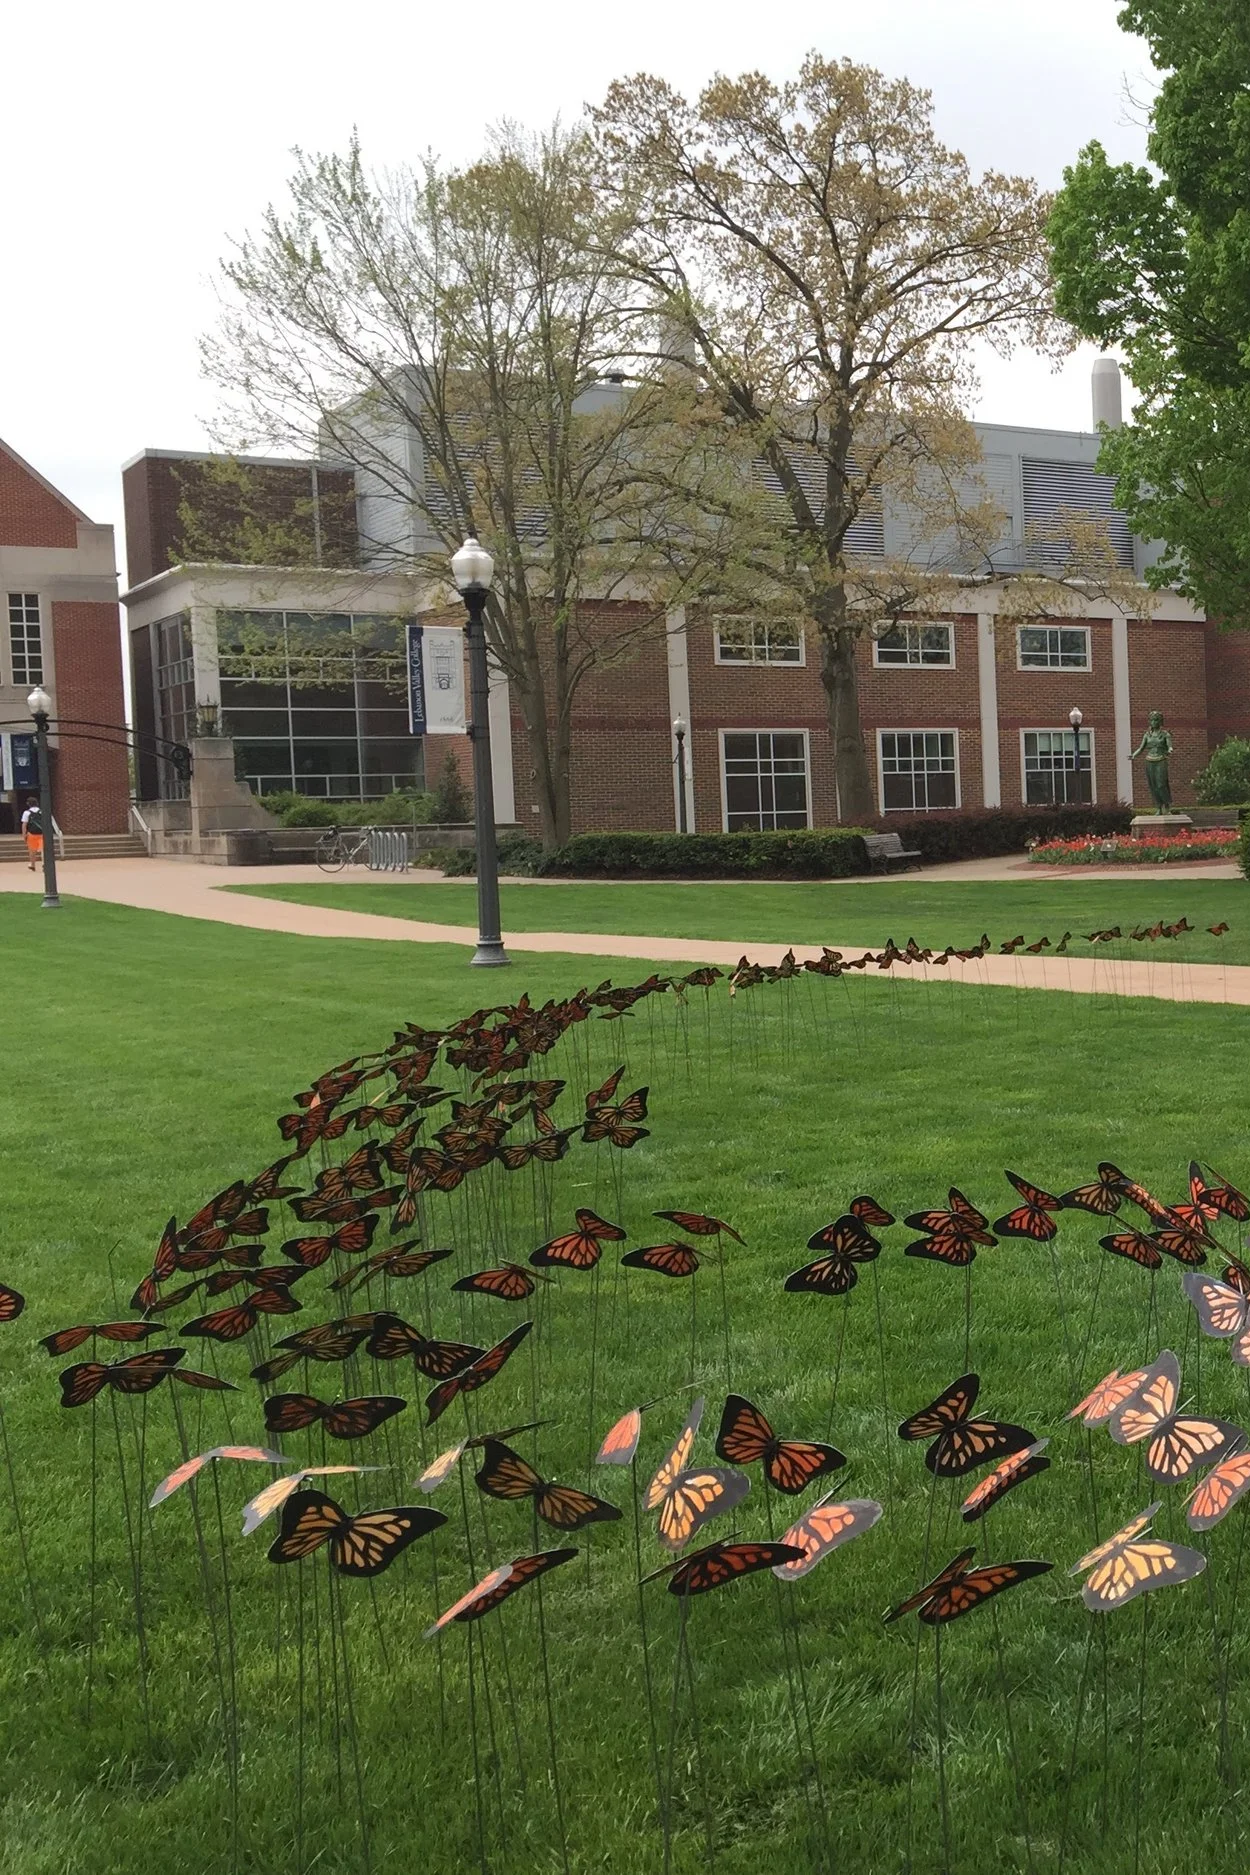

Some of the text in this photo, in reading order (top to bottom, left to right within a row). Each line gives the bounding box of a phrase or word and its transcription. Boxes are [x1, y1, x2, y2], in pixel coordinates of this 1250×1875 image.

[411, 639, 424, 722] Lebanon Valley College
